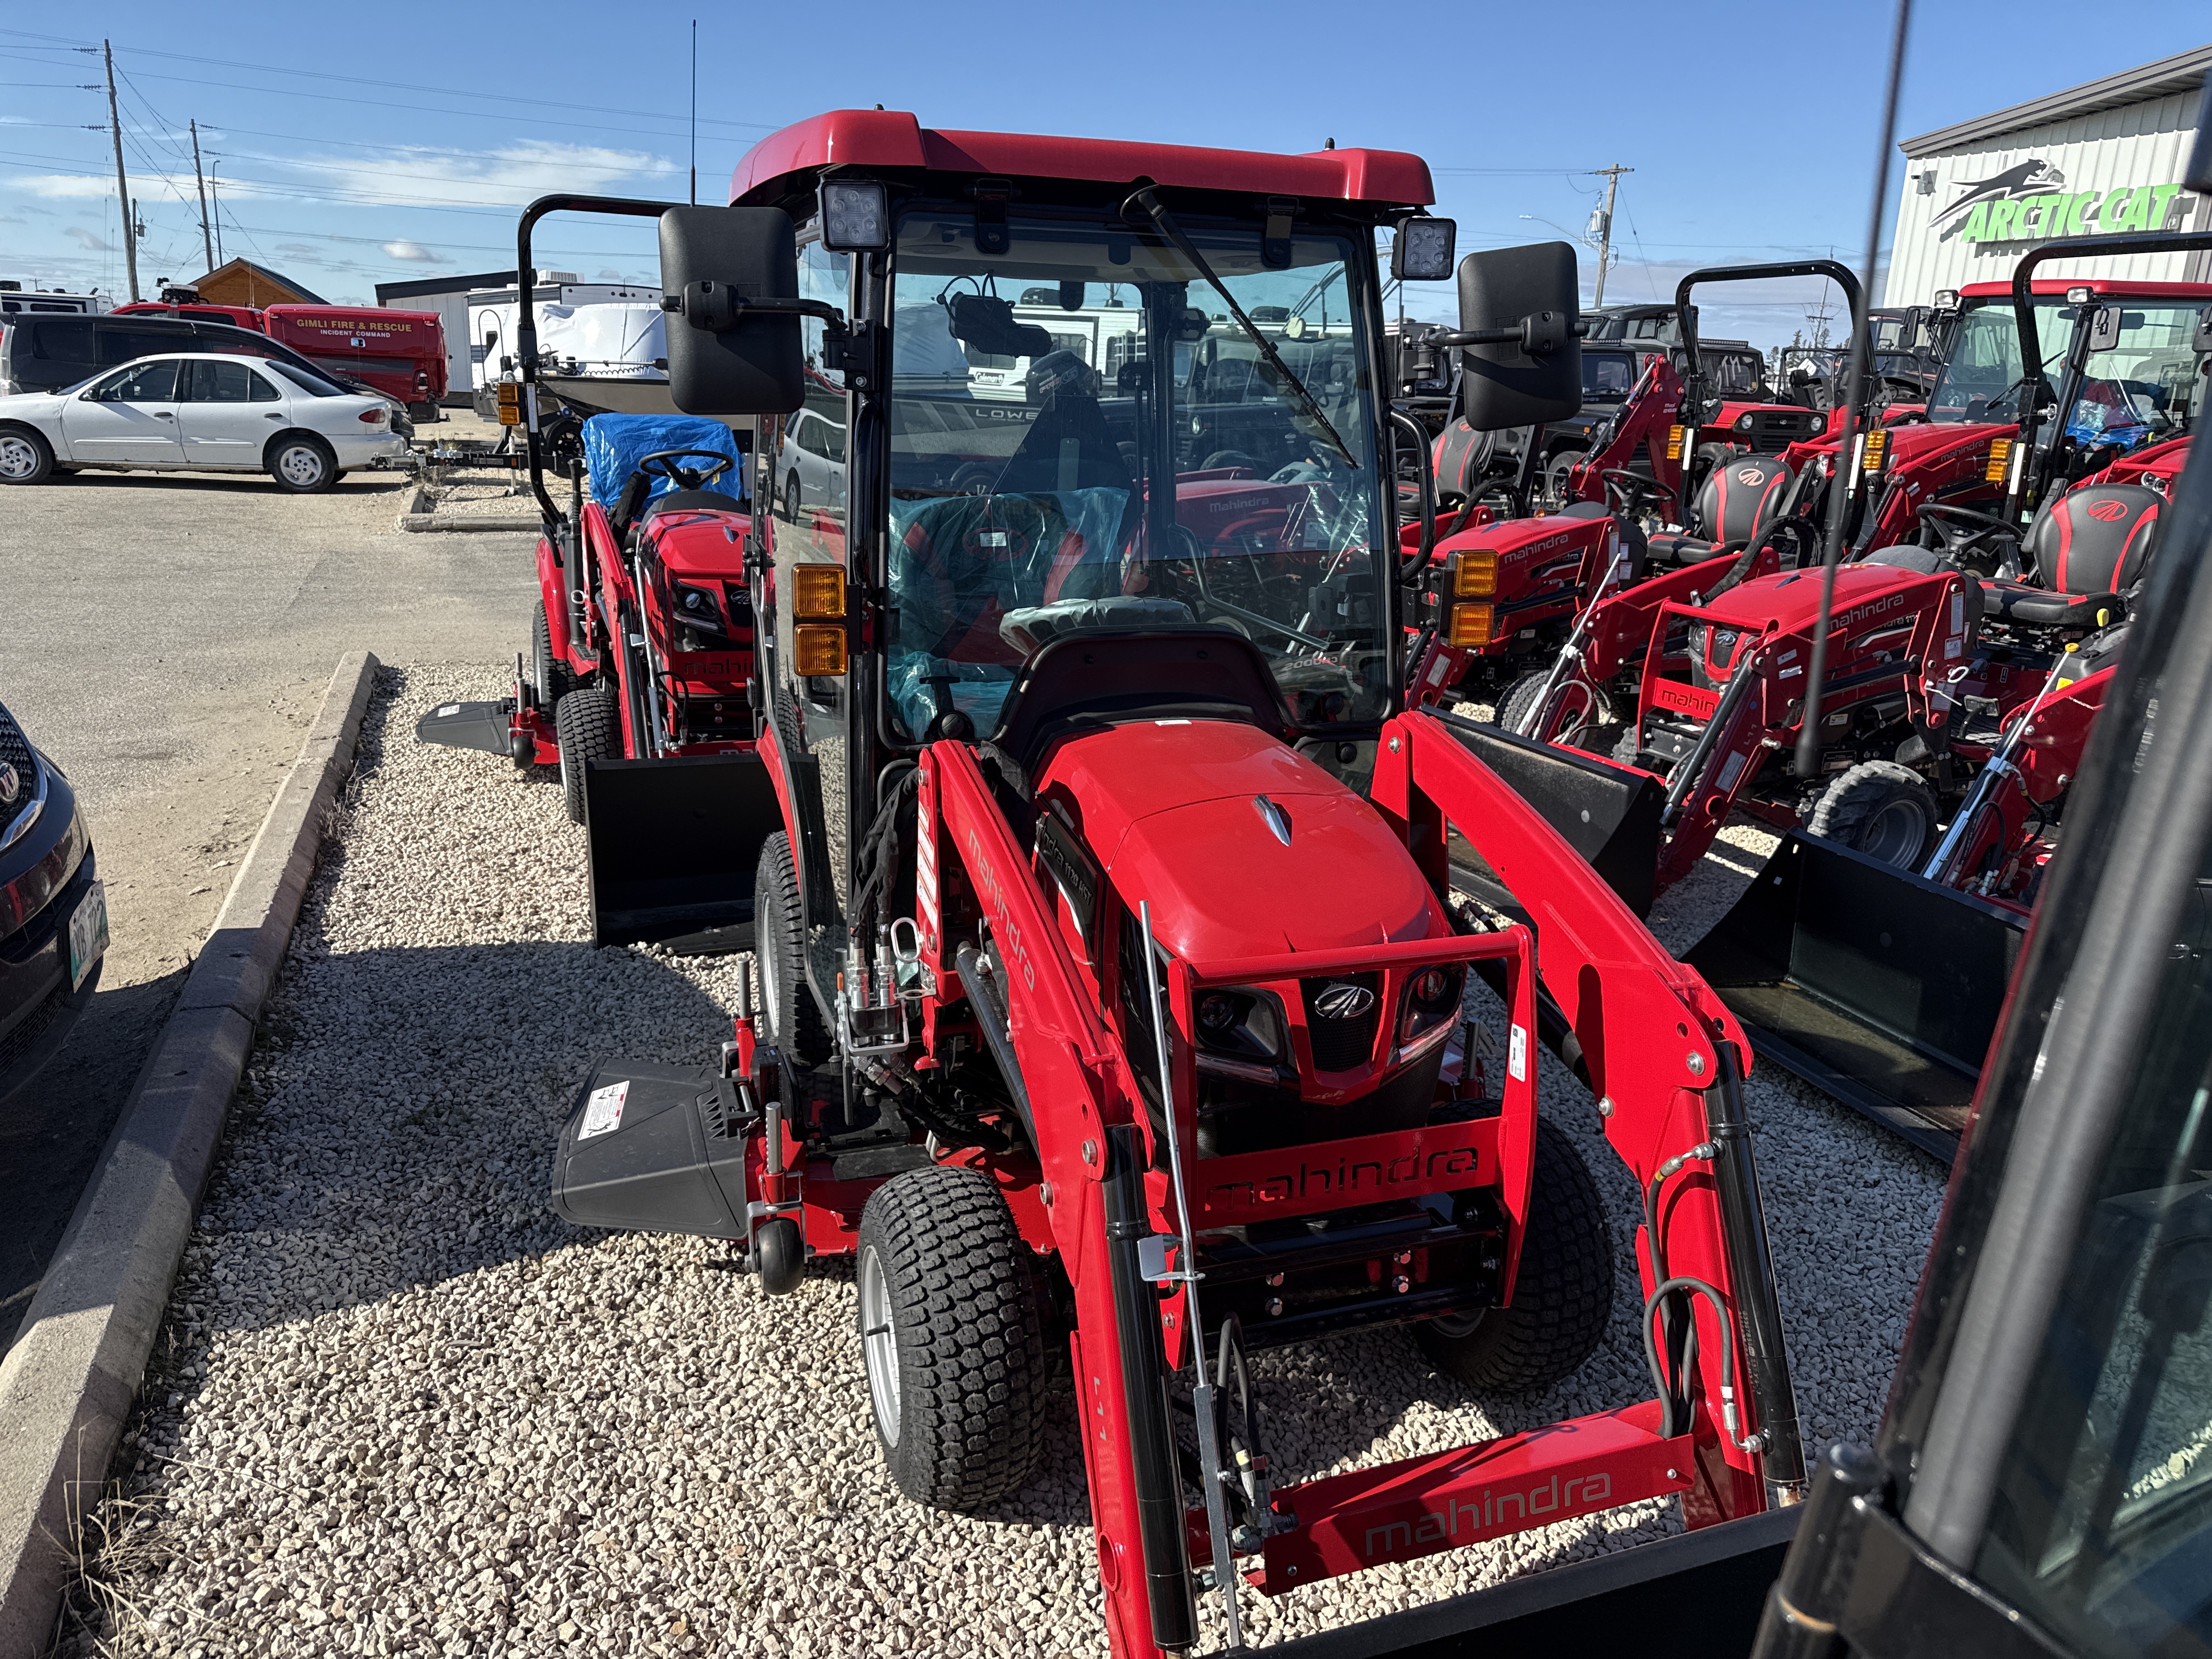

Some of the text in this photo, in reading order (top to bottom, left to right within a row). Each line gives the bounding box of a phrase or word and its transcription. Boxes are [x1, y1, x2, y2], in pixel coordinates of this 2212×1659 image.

[1960, 183, 2181, 242] ARCTIC CAT
[296, 319, 412, 332] GIMLI FIRE & RESCUE
[975, 371, 998, 383] Coleman
[976, 409, 1039, 420] LOWE
[1940, 439, 1985, 462] mahindra
[1209, 497, 1269, 513] Mahindra
[1504, 534, 1568, 564] mahindra
[1661, 690, 1716, 713] mahin
[969, 828, 1035, 992] mahindra
[1205, 1146, 1479, 1211] mahindra
[1365, 1472, 1611, 1556] mahindra
